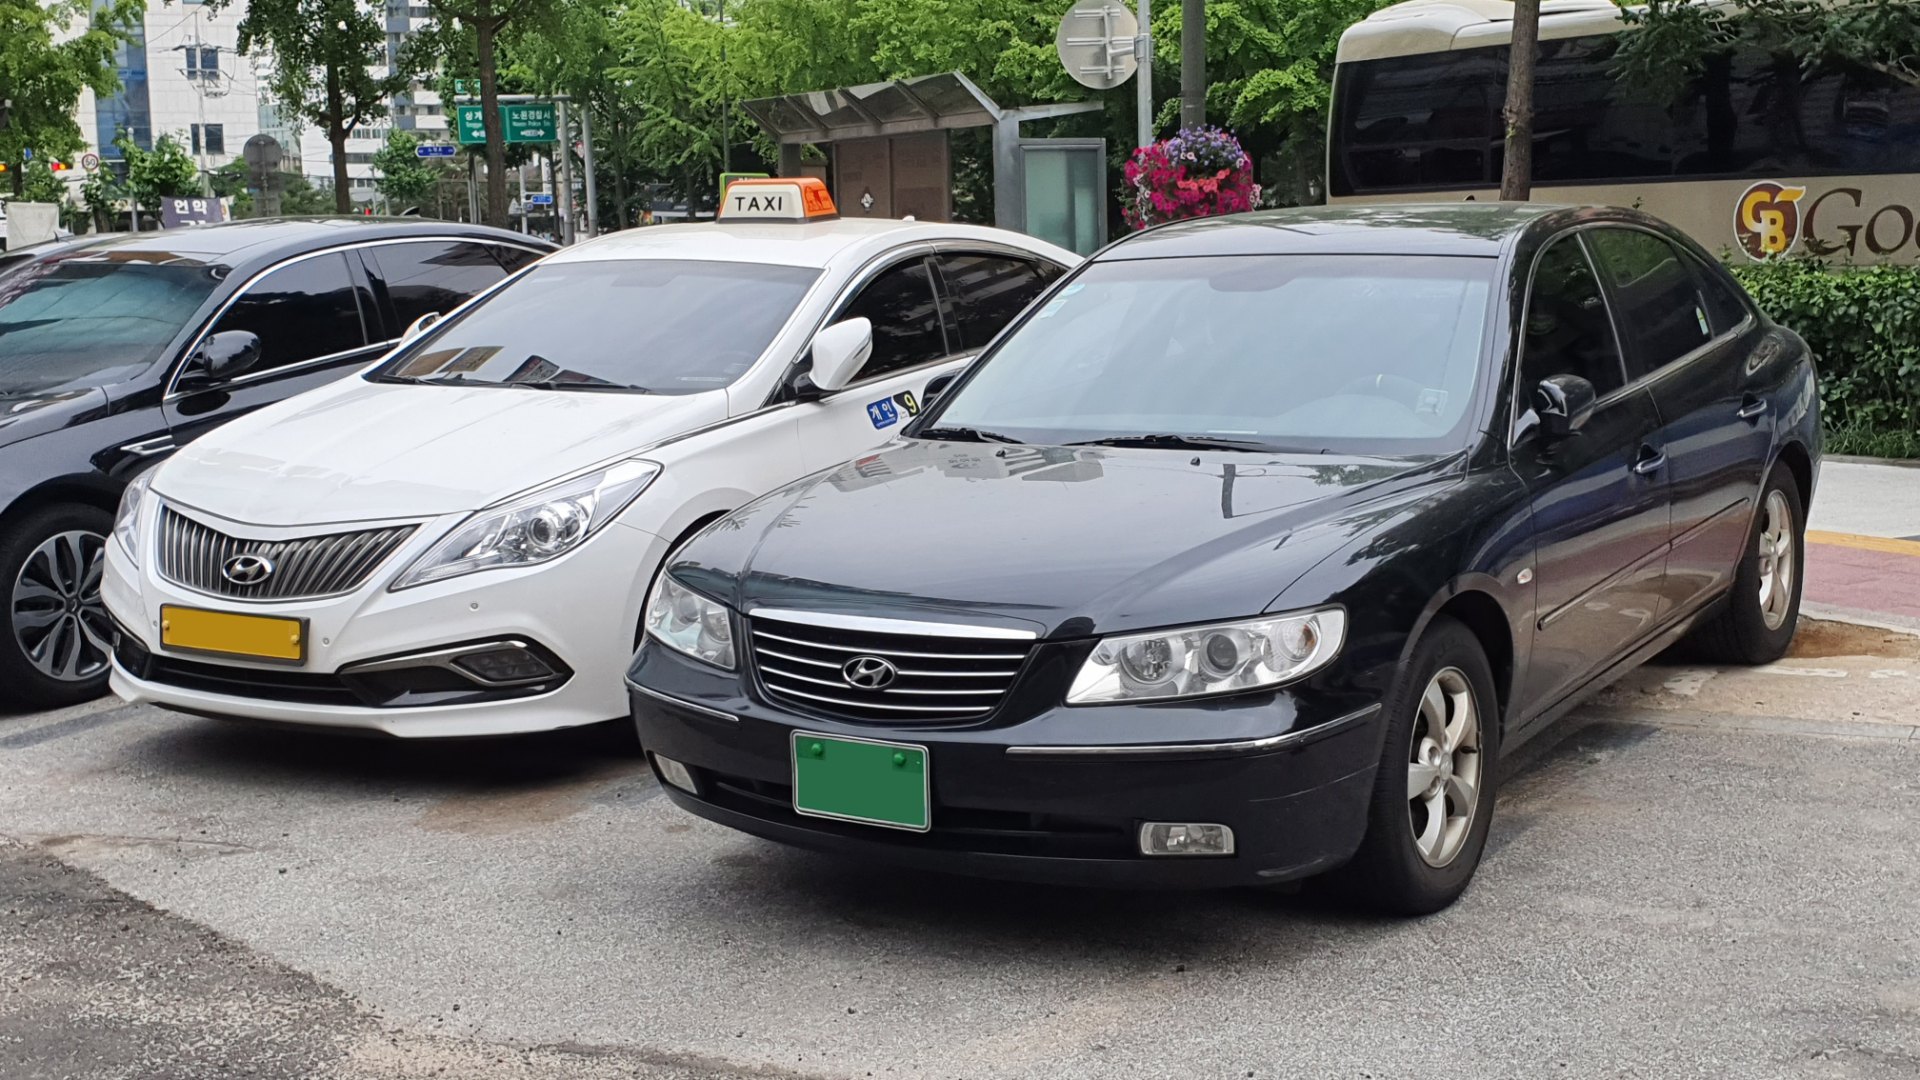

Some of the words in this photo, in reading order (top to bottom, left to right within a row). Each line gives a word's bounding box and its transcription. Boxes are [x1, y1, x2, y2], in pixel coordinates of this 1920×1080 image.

[734, 196, 783, 211] TAXI
[1803, 187, 1920, 256] Go
[869, 401, 895, 420] 개인
[903, 393, 917, 413] 9
